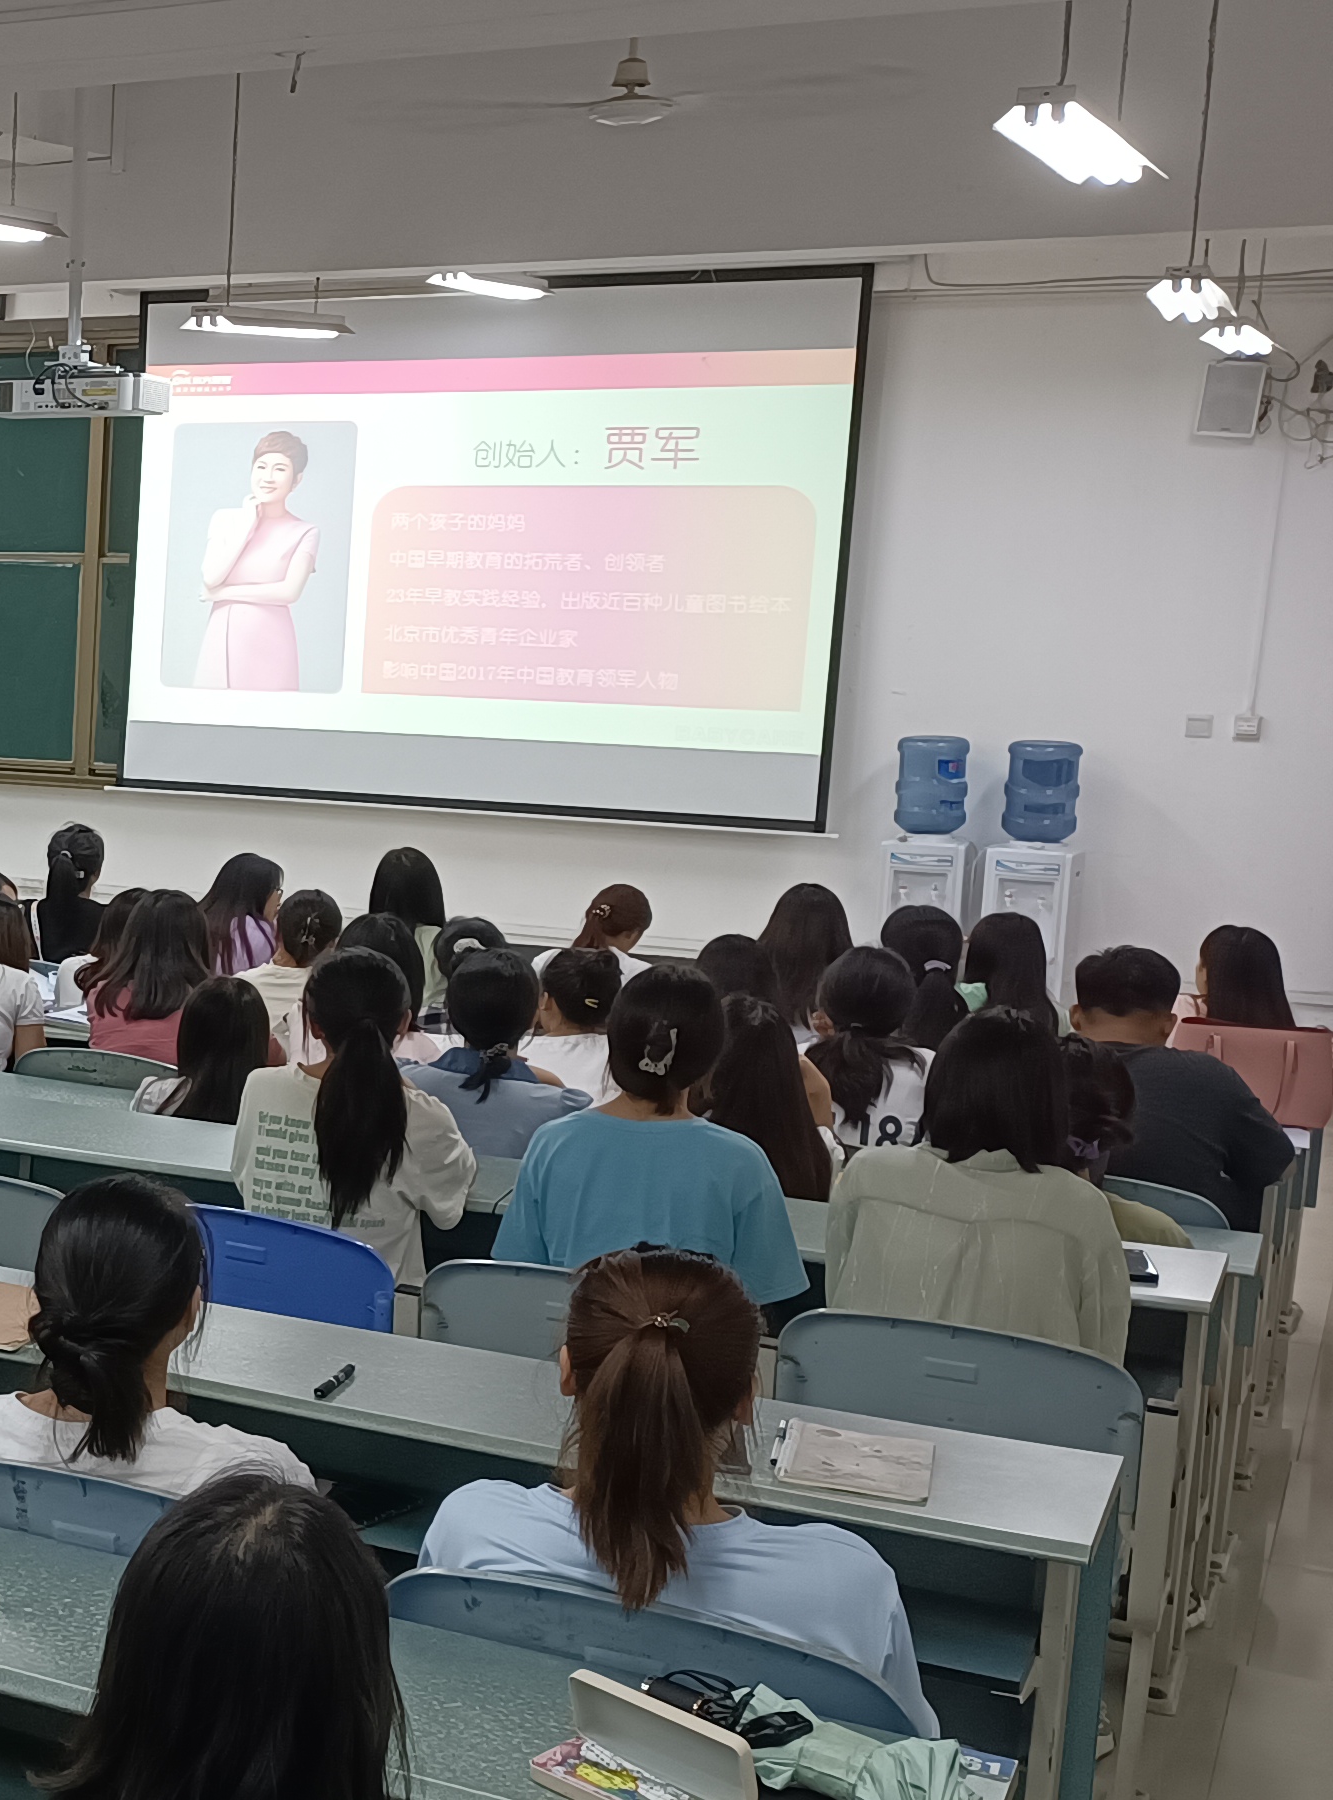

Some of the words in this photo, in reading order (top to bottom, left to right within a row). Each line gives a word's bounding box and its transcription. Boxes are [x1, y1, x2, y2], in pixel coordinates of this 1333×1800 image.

[604, 426, 701, 470] 贾军
[391, 512, 526, 533] 两个孩子的妈妈
[384, 624, 578, 649] 北京市优秀青年企业家
[382, 660, 679, 692] 影响中国2017年中国教育领军人物
